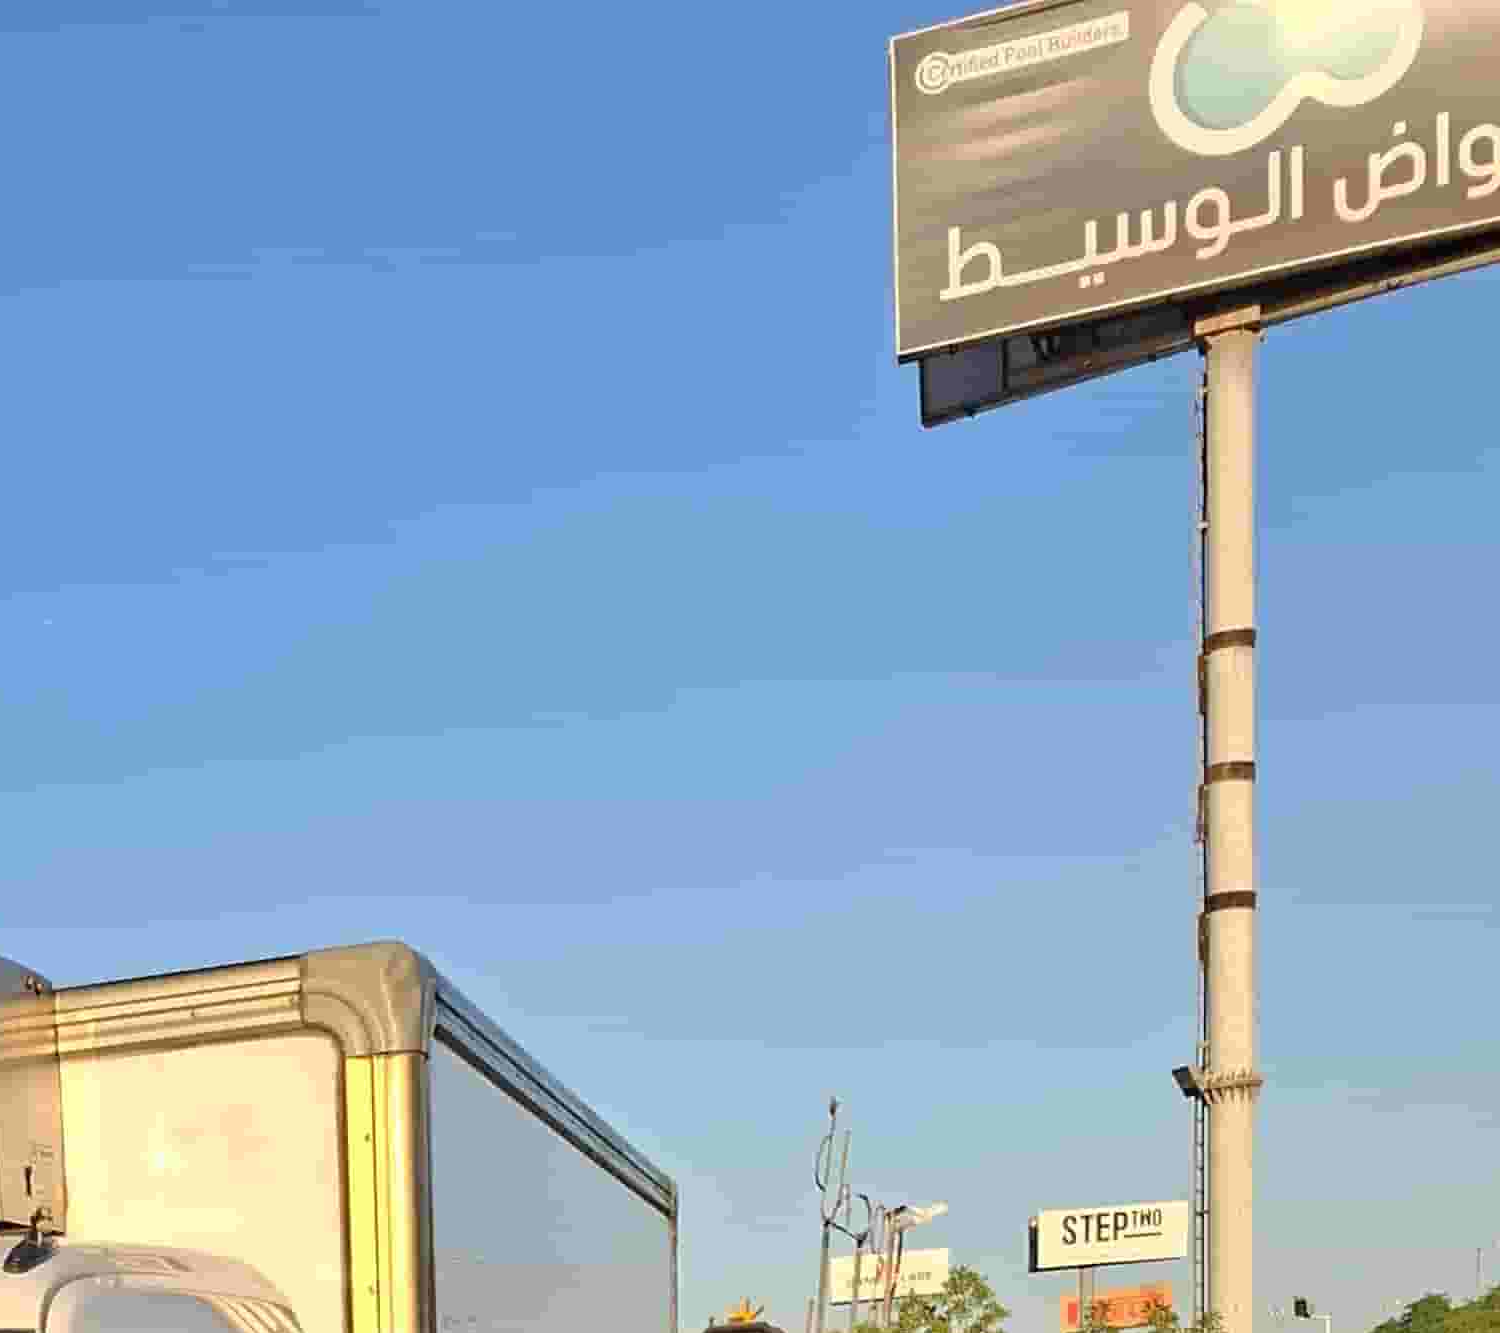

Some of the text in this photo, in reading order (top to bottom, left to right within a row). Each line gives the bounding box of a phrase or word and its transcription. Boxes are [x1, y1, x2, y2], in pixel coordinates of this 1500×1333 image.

[1004, 39, 1044, 65] Pool
[940, 145, 1304, 301] الوسيط
[1061, 1208, 1163, 1247] STEP TWO
